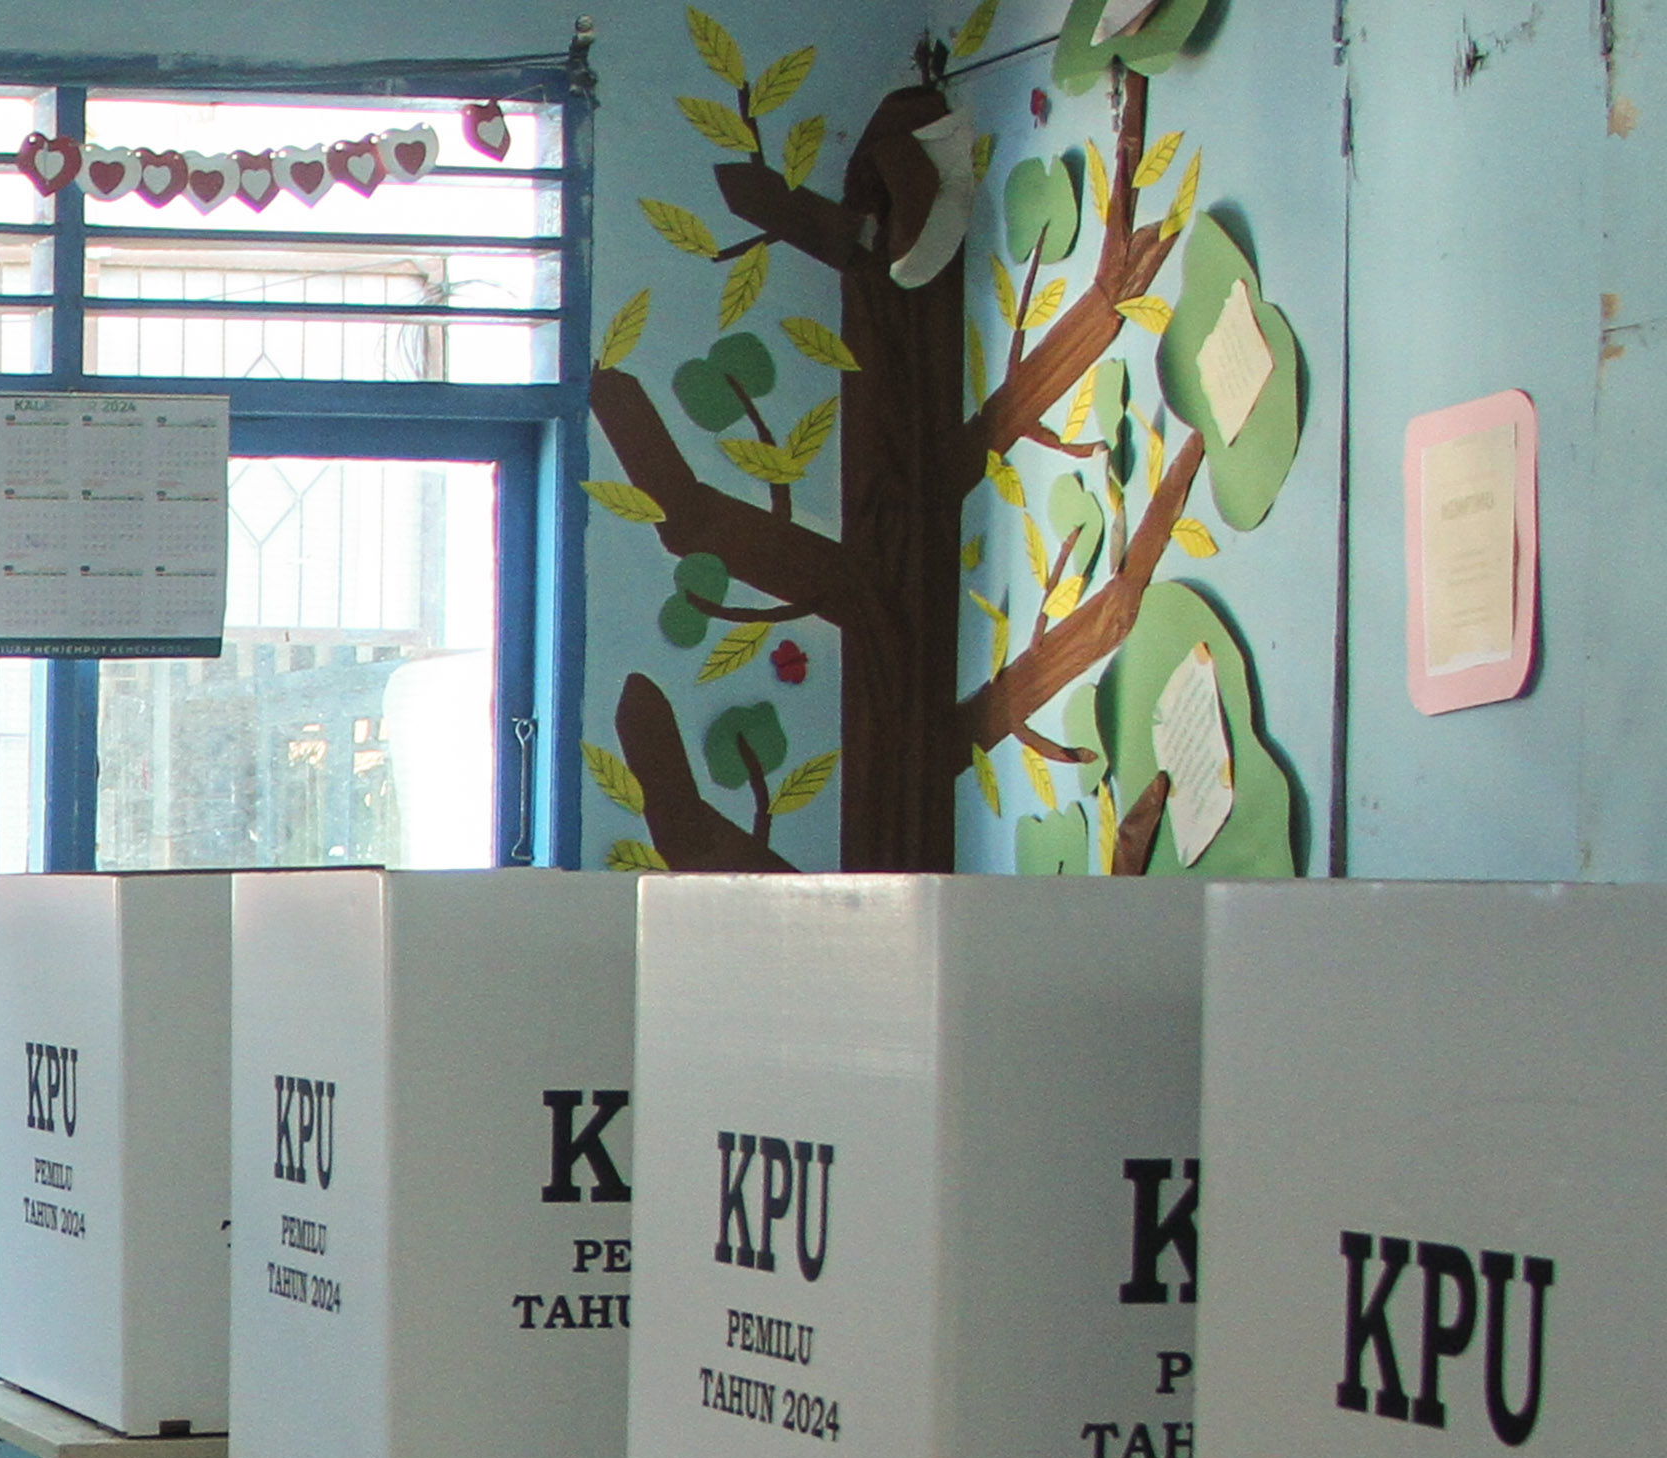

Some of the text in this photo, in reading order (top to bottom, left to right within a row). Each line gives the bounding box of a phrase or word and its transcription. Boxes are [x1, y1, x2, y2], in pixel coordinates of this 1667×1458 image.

[14, 400, 137, 413] KALER 2024
[34, 645, 107, 654] MENJEMPUT
[25, 1041, 79, 1137] KPU
[273, 1073, 337, 1190] KPU
[33, 1158, 73, 1191] PEMILU
[23, 1196, 86, 1239] TAHUN 2024
[714, 1130, 835, 1283] KPU
[281, 1215, 328, 1256] PEMILU
[267, 1262, 342, 1314] TAHUN 2024
[725, 1308, 815, 1368] PEMILU
[1335, 1230, 1555, 1448] KPU
[699, 1367, 841, 1442] TAHUN 2024
